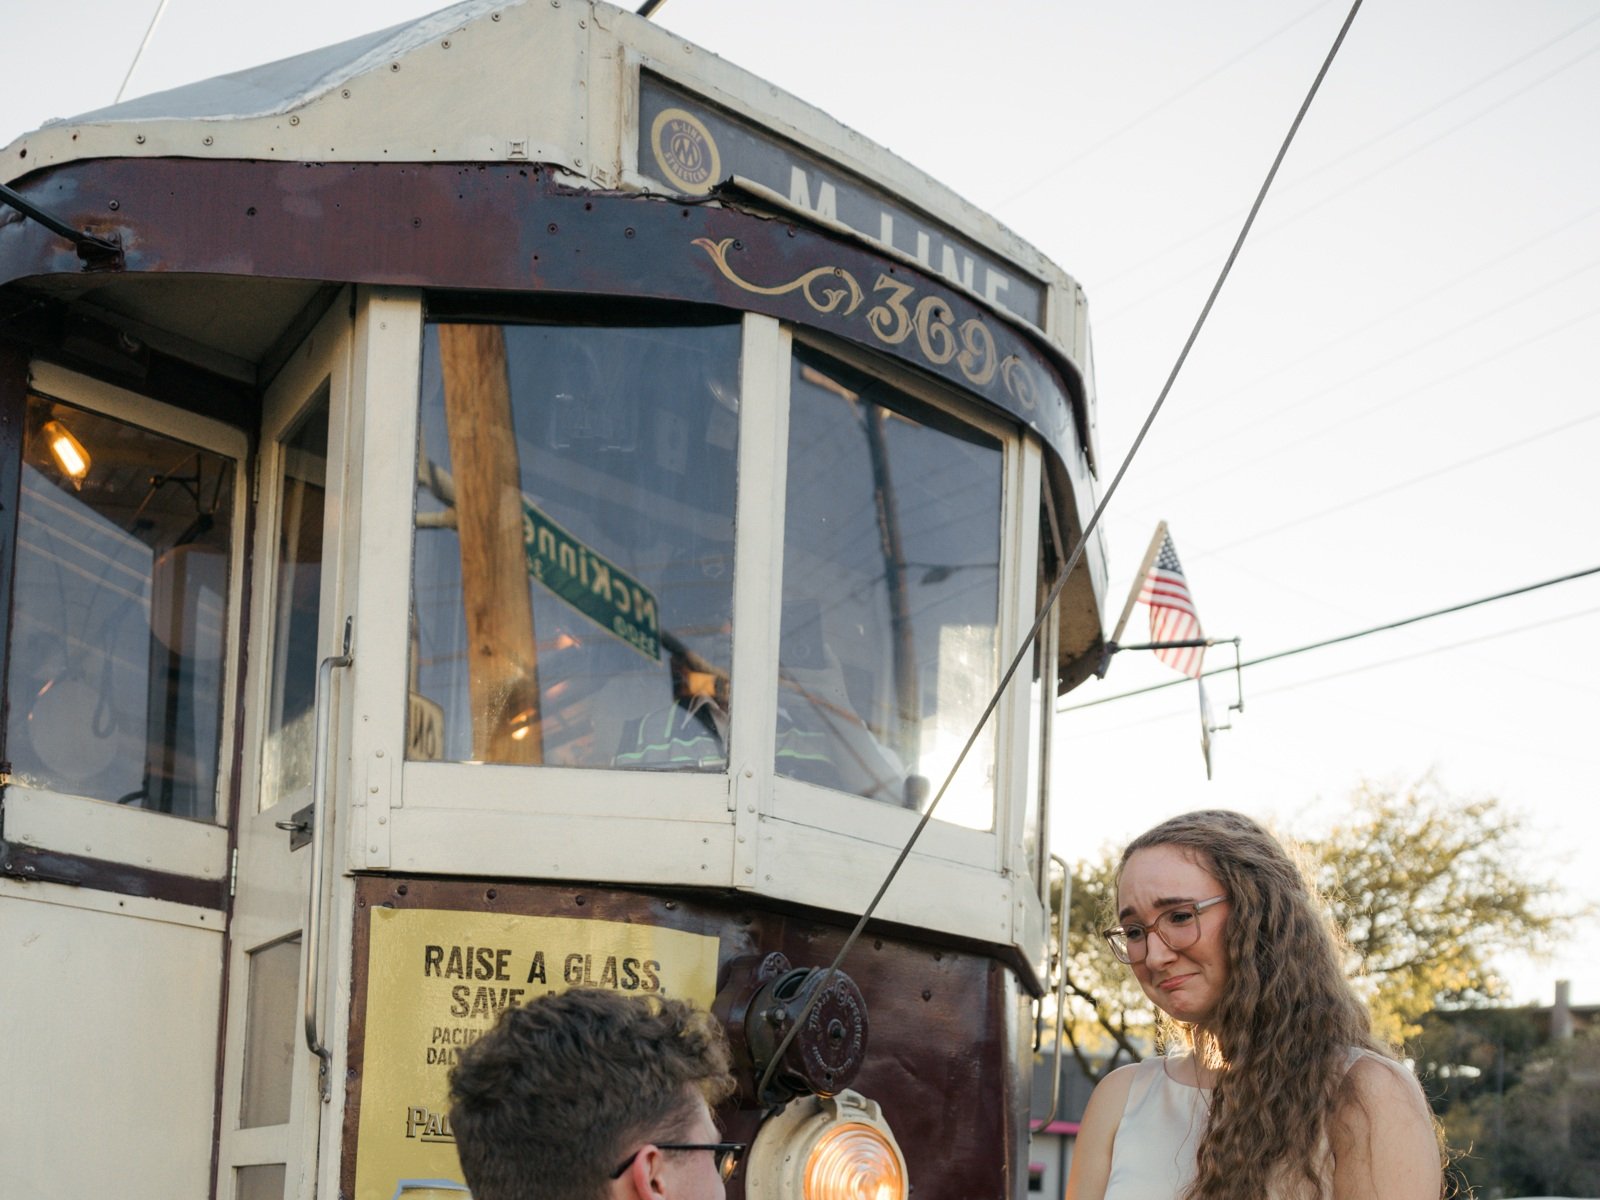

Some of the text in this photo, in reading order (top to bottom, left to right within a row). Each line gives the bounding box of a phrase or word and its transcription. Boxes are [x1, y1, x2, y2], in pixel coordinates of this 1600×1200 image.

[866, 272, 1000, 386] 369
[424, 944, 511, 981] RAISE
[527, 950, 547, 985] A
